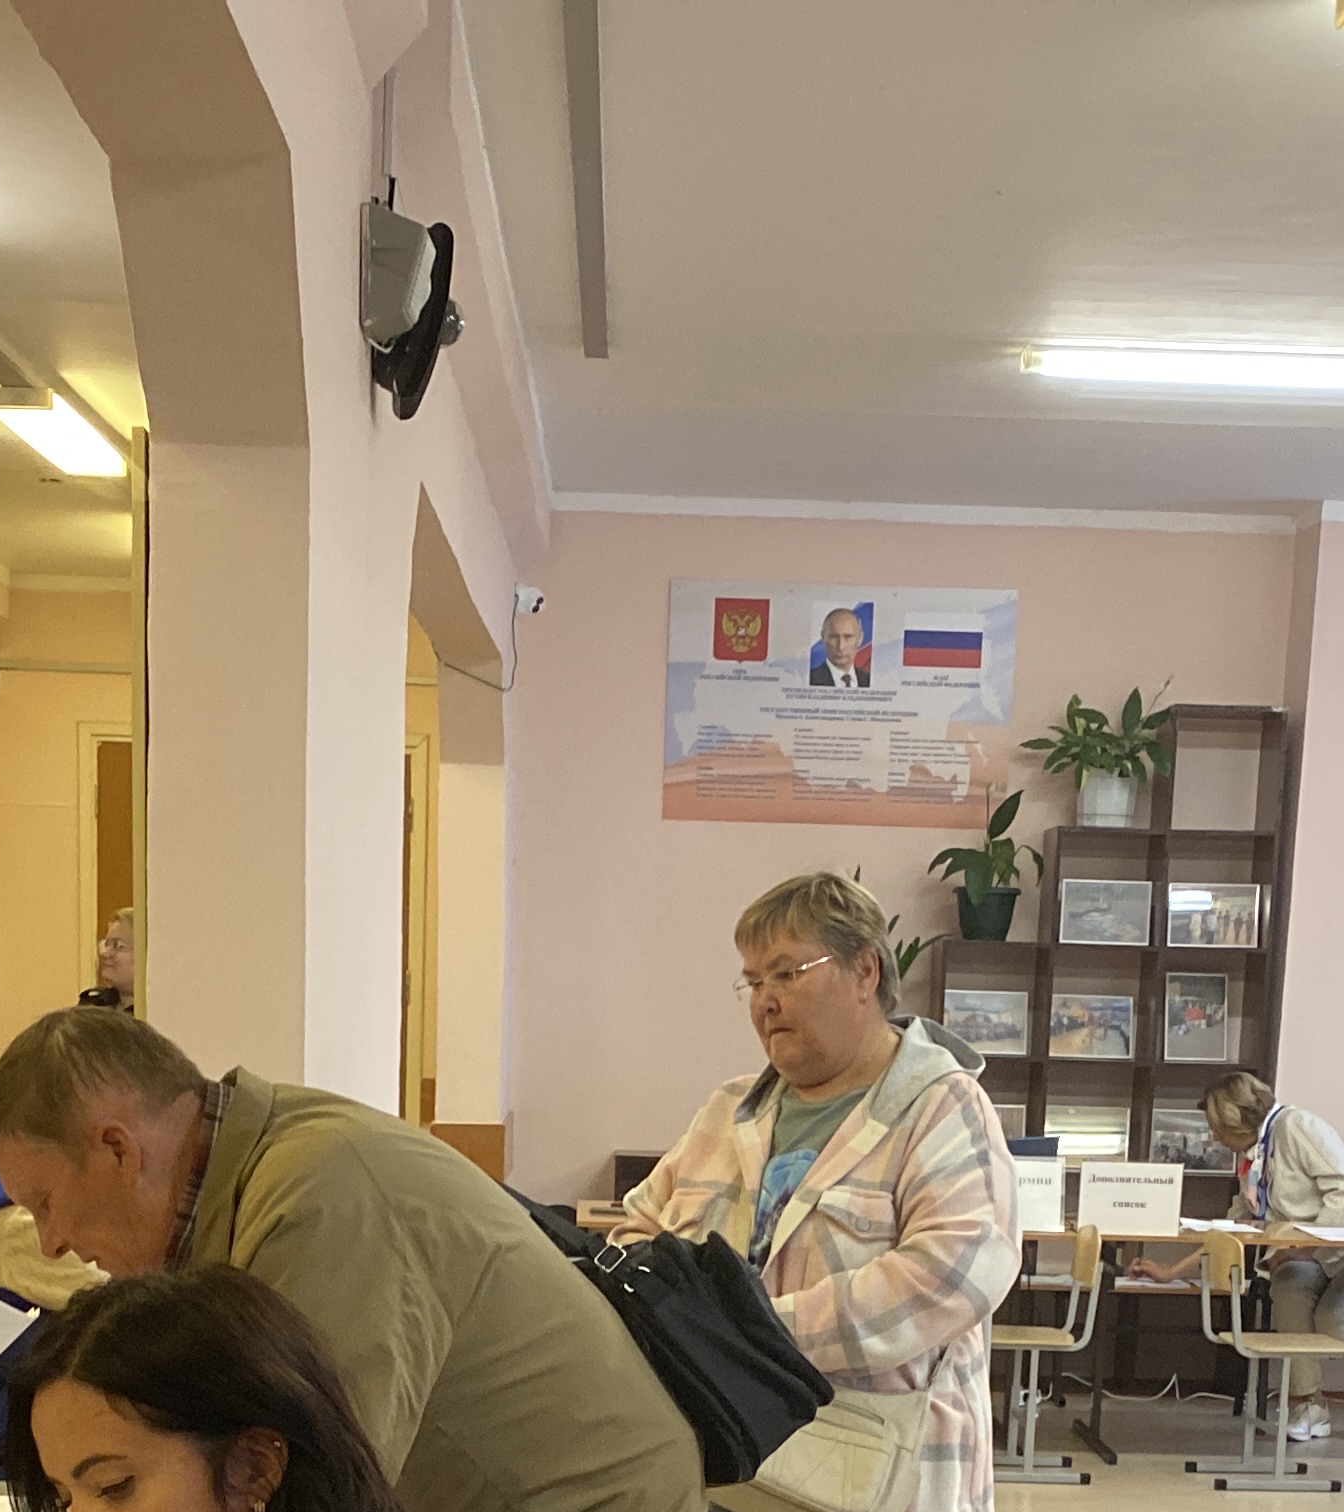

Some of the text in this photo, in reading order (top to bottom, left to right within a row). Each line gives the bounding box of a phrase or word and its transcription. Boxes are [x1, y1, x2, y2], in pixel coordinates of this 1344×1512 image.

[1018, 1174, 1053, 1187] рмии
[1087, 1173, 1175, 1185] Дополнительный
[1112, 1200, 1147, 1209] список
